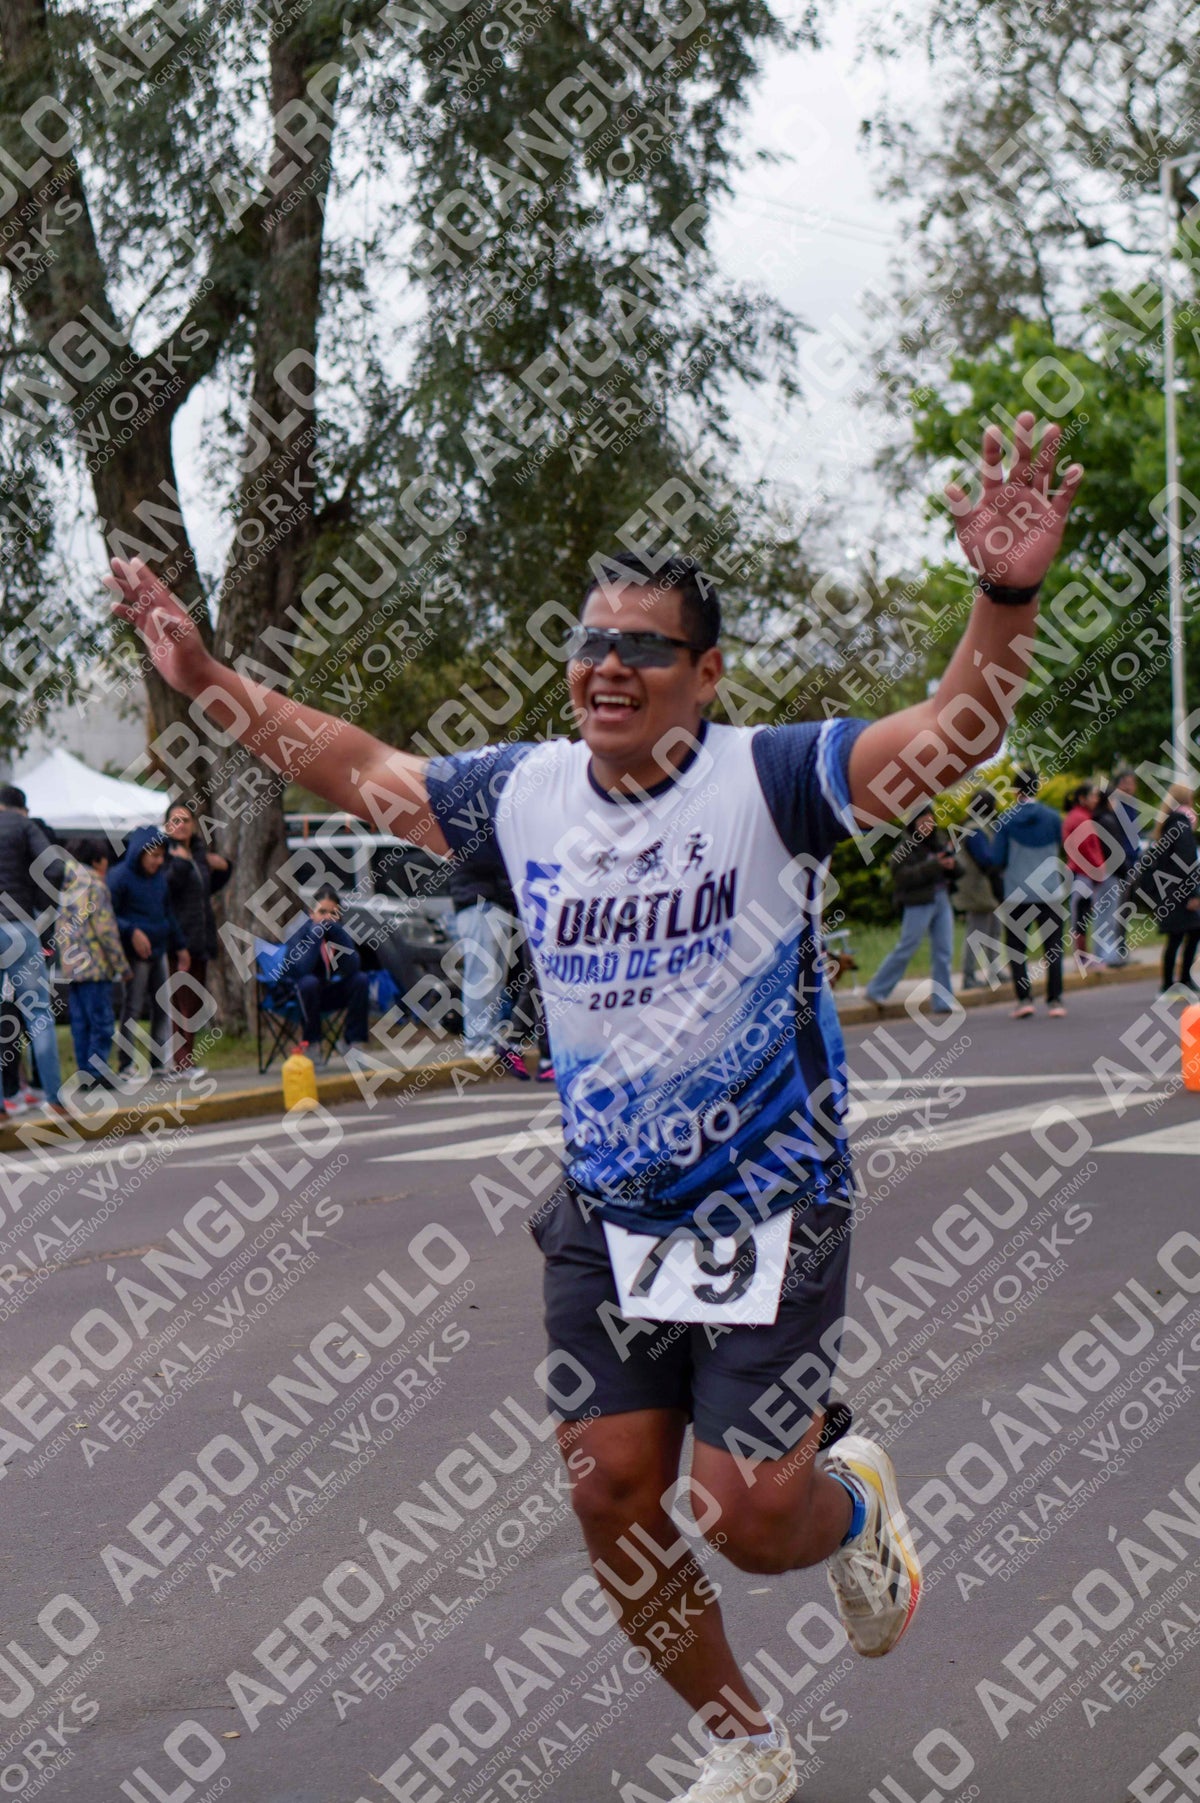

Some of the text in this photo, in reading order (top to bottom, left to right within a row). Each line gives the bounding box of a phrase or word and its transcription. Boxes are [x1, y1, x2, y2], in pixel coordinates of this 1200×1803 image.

[555, 866, 738, 948] DUATLÓN
[540, 927, 732, 985] UDAD DE GOYA
[589, 986, 654, 1011] 2026
[628, 1232, 758, 1305] 79
